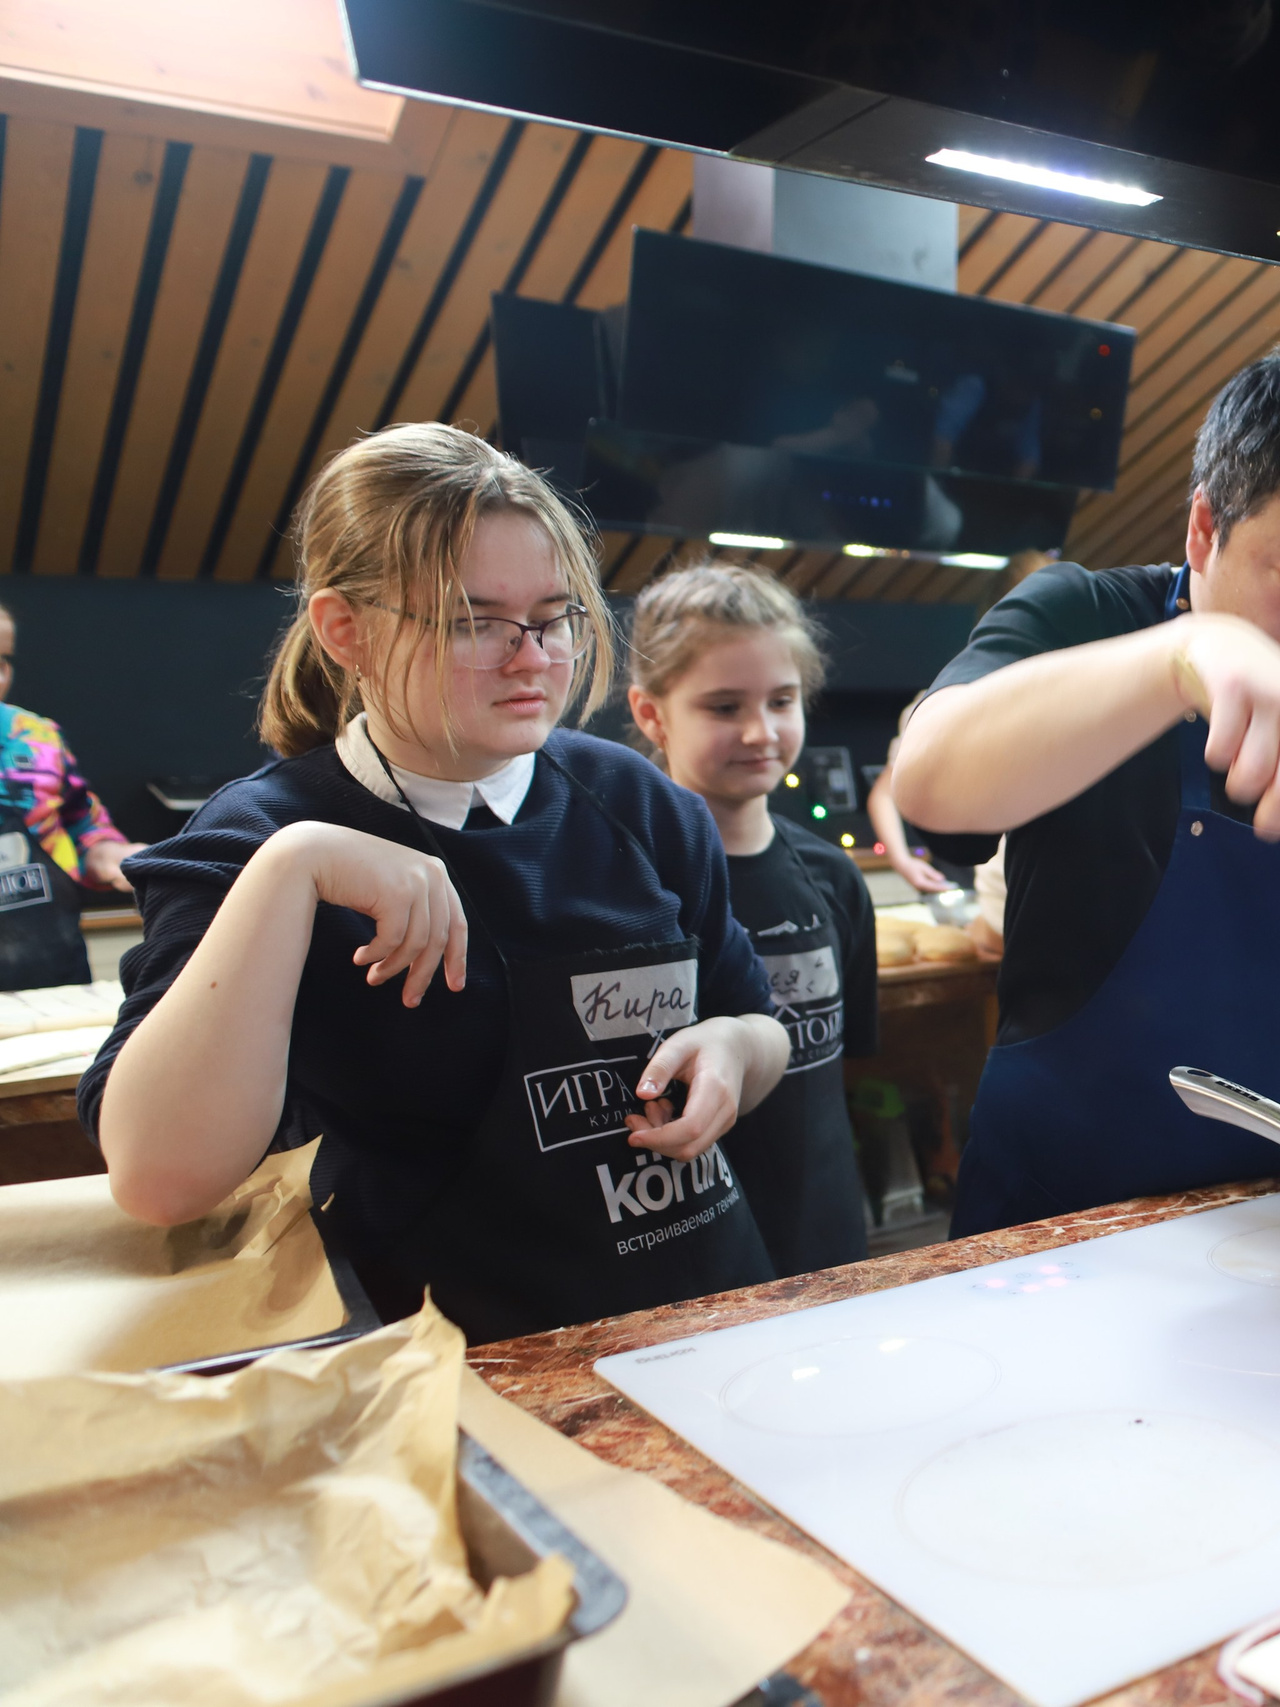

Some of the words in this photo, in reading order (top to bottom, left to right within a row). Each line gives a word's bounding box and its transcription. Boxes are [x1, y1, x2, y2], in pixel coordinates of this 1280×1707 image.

[582, 981, 691, 1028] Кира
[535, 1069, 635, 1119] ИГРА
[589, 1108, 633, 1127] КУЛИ
[616, 1206, 716, 1255] встраиваемая
